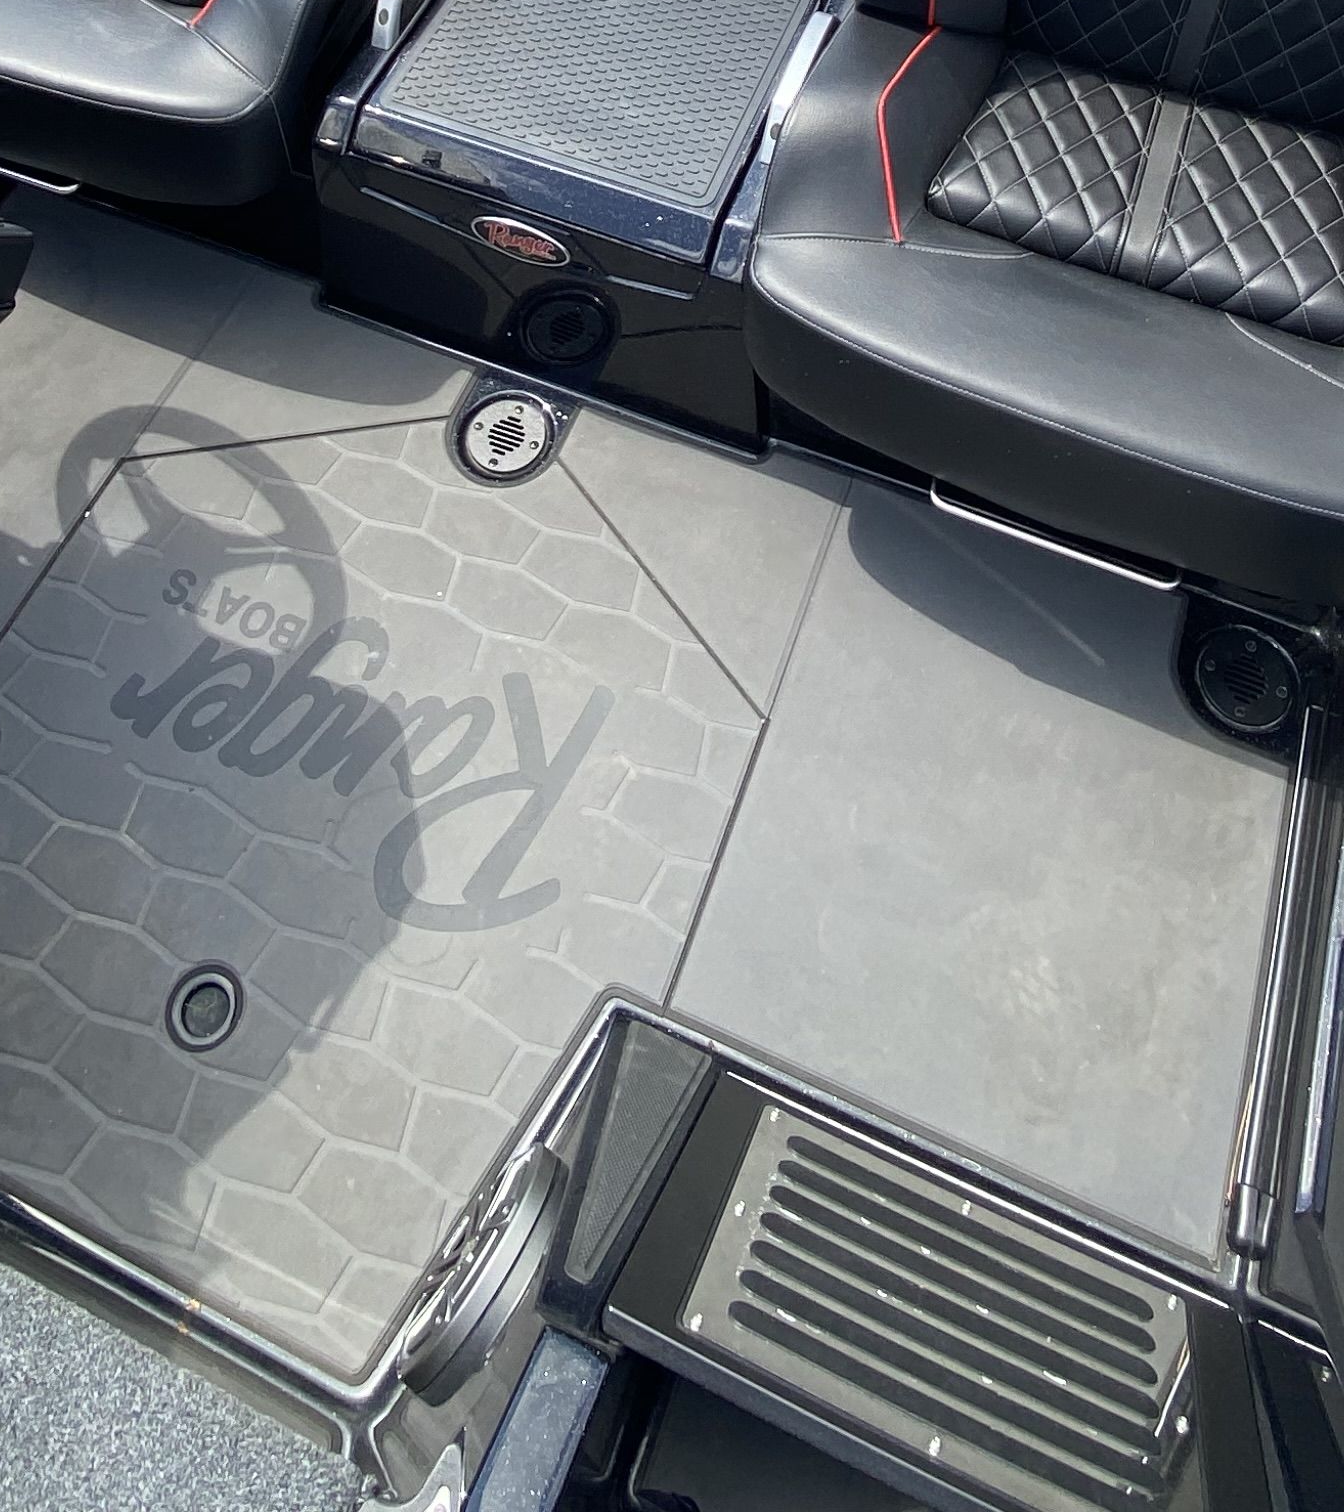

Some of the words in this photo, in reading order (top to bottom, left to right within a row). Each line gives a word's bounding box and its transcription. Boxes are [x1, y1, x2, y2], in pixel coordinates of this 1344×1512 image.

[483, 220, 555, 256] Ranger
[162, 568, 307, 653] BOATS
[110, 616, 616, 933] Ranger
